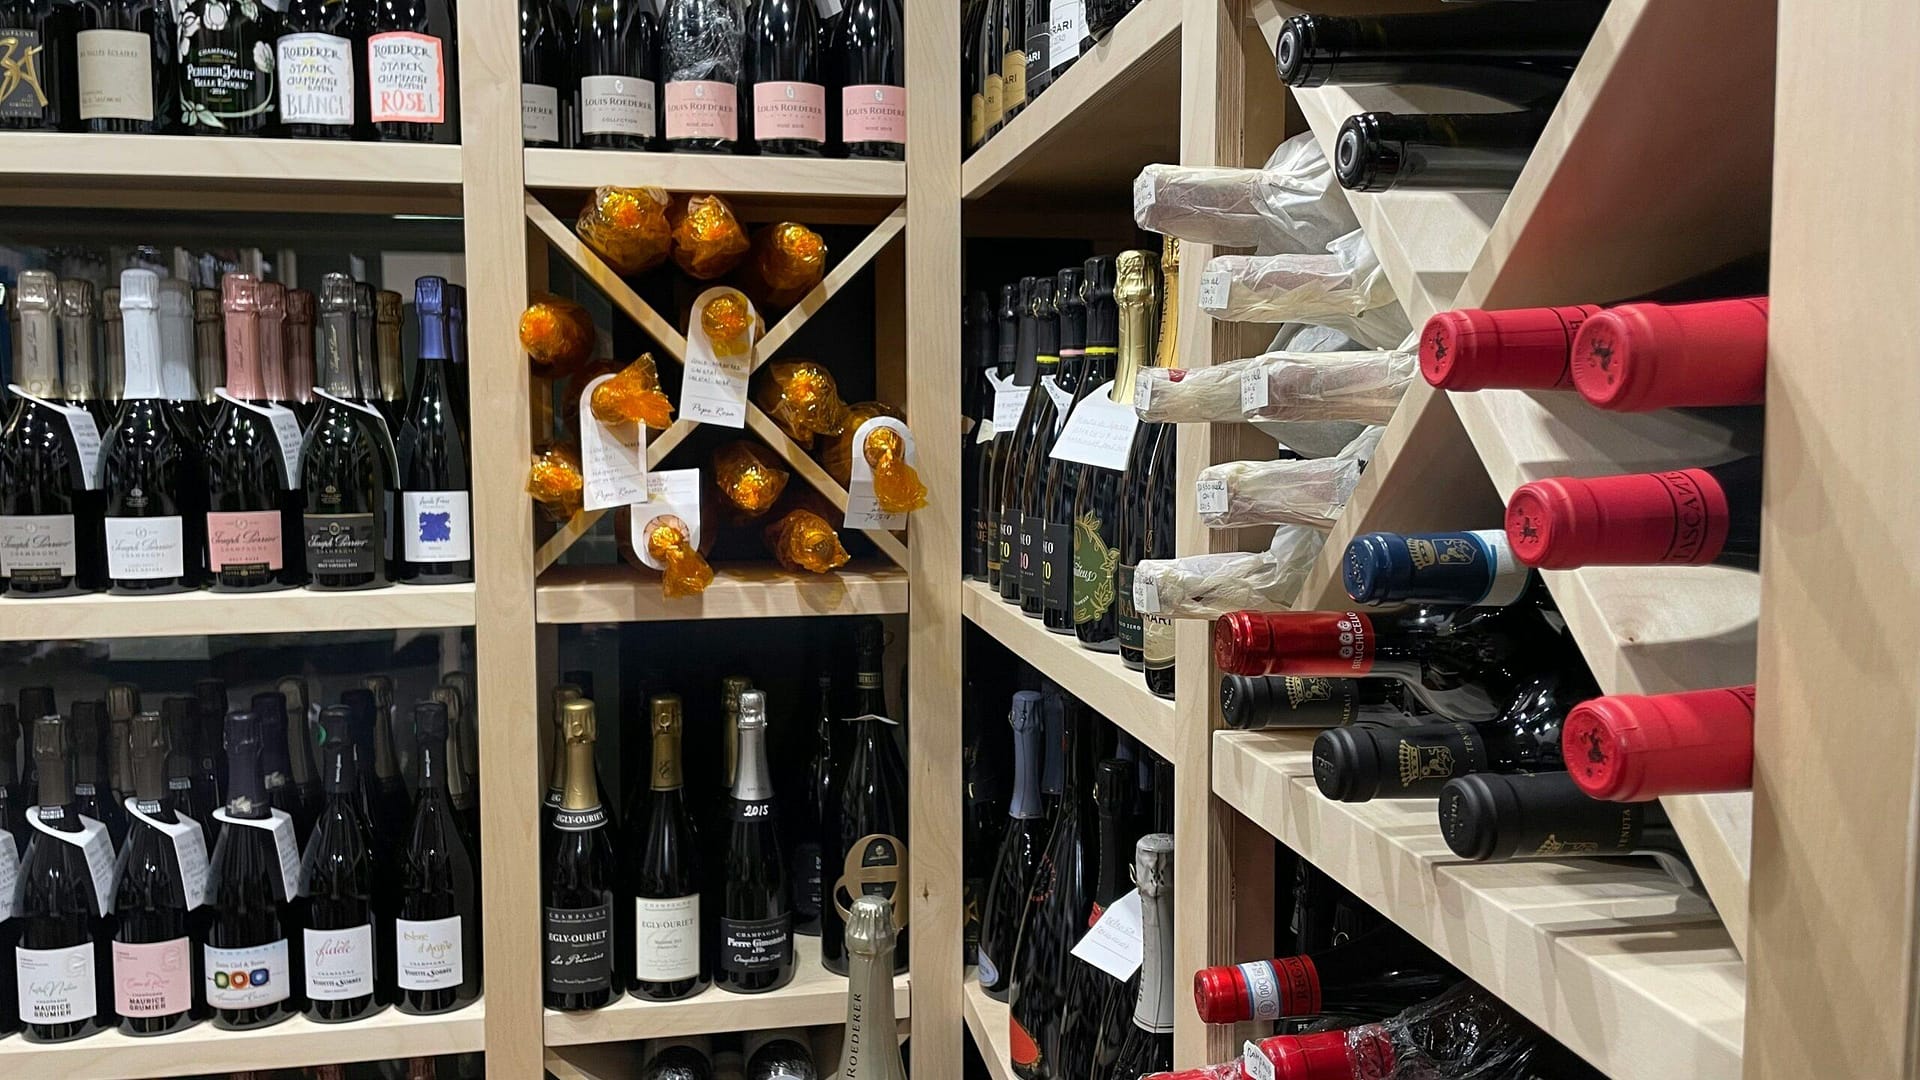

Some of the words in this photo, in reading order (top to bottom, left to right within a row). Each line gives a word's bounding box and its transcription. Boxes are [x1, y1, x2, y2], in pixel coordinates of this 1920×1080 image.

[198, 47, 237, 59] CHAMPAGNE
[282, 46, 342, 61] ROEDERER
[374, 44, 432, 60] ROEDERER
[289, 63, 335, 75] STARCK
[380, 61, 425, 73] STARCK
[585, 98, 607, 107] LOUIS
[609, 97, 652, 110] ROEDERER
[668, 103, 688, 112] LOUIS
[689, 102, 733, 113] ROEDERER
[757, 104, 778, 113] LOUIS
[781, 103, 822, 115] ROEDERER
[846, 107, 868, 116] LOUIS
[870, 106, 904, 117] ROEDER
[743, 804, 769, 817] 2015
[556, 811, 604, 824] EGLY-OURIET
[1617, 809, 1632, 849] TENUTA
[644, 900, 691, 908] CHAMPAGNE
[549, 909, 606, 919] CHAMPAGNE
[642, 918, 694, 929] EGLY-OURIET
[548, 929, 607, 943] EGLY-OURIET
[736, 929, 779, 938] CHAMPAGNE
[727, 937, 752, 948] Pierre
[34, 1003, 71, 1011] MAURICE
[129, 997, 166, 1005] MAURICE
[129, 1003, 166, 1011] GRUMIER
[34, 1010, 72, 1018] GRUMIER
[846, 993, 863, 1078] ROEDERER
